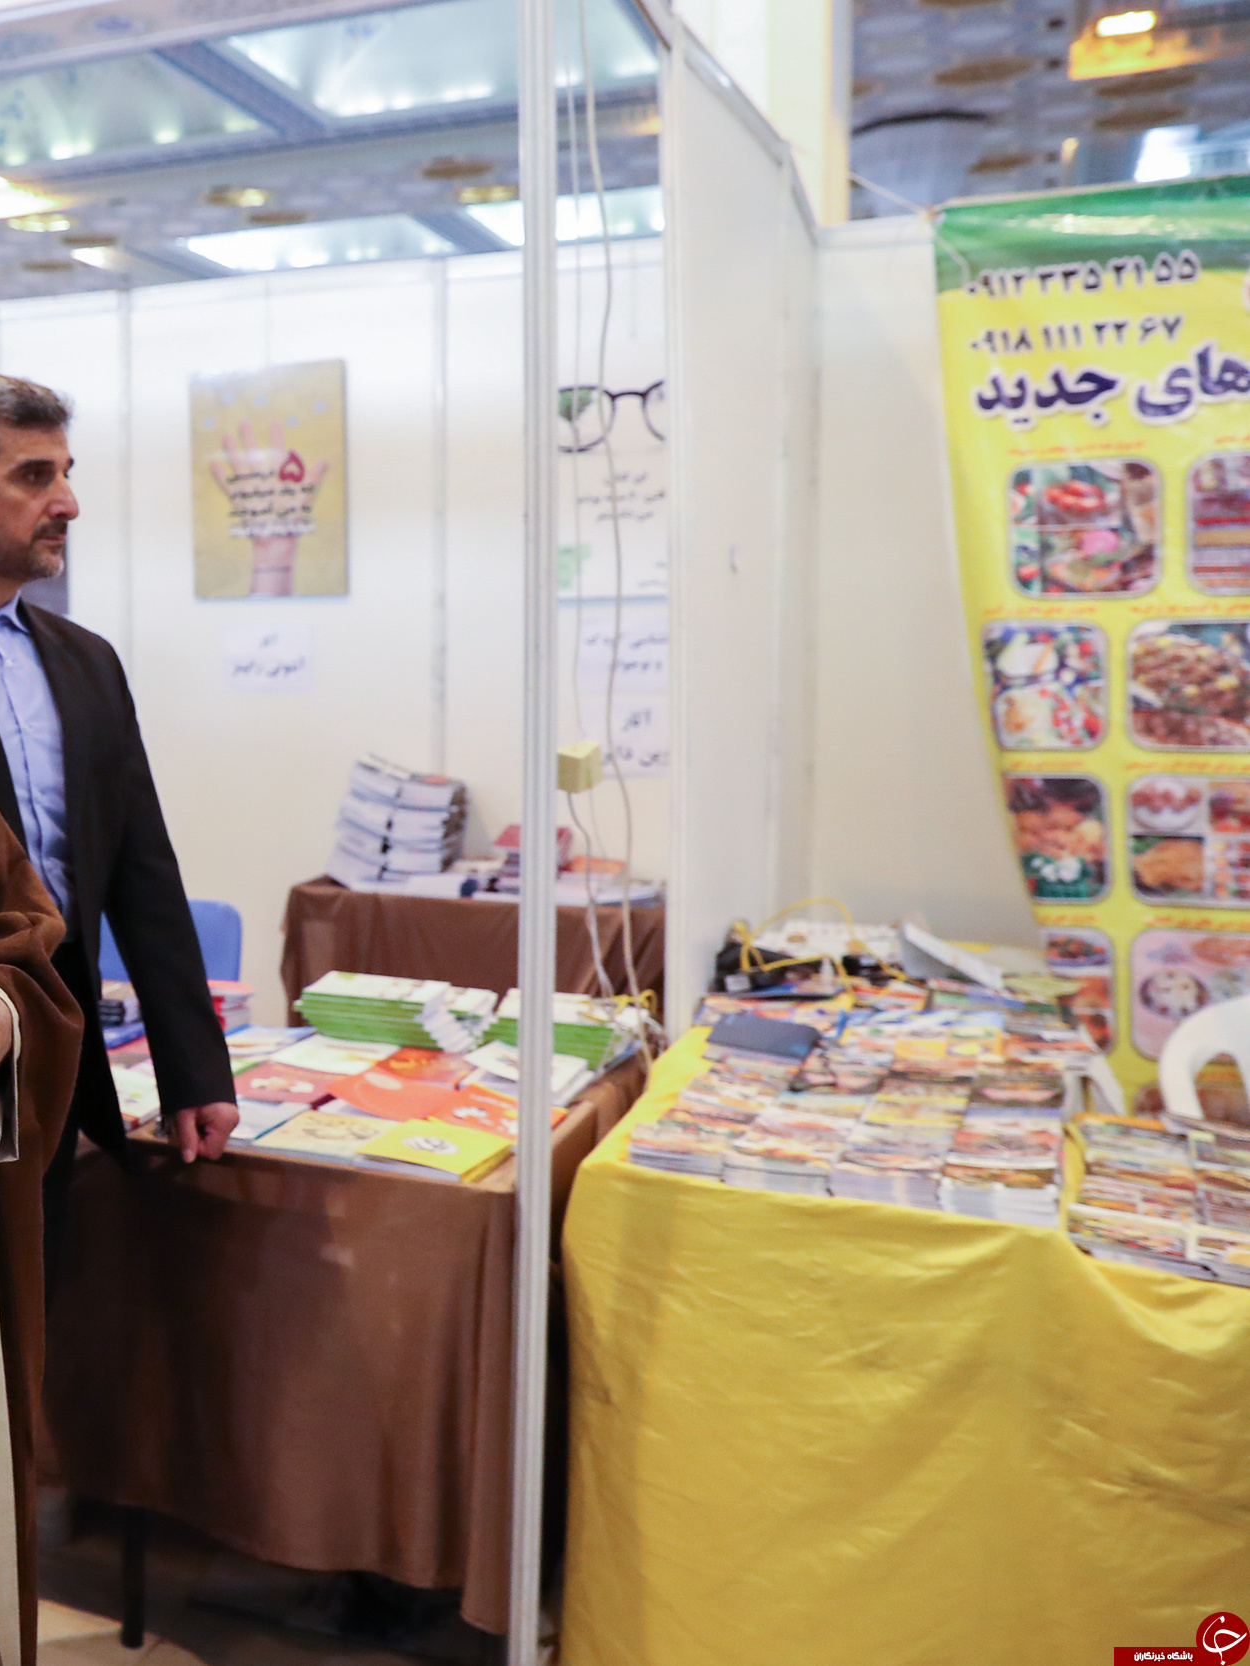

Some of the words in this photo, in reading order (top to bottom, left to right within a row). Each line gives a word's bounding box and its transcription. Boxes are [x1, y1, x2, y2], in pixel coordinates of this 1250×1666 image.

[968, 274, 1026, 297] ۰۹۱۲
[1155, 256, 1198, 282] ۵۵
[970, 327, 1033, 351] ۰۹۱۸
[1042, 323, 1083, 349] ۱۱۱
[1138, 314, 1183, 342] ۶۷
[977, 368, 1119, 424] جدید
